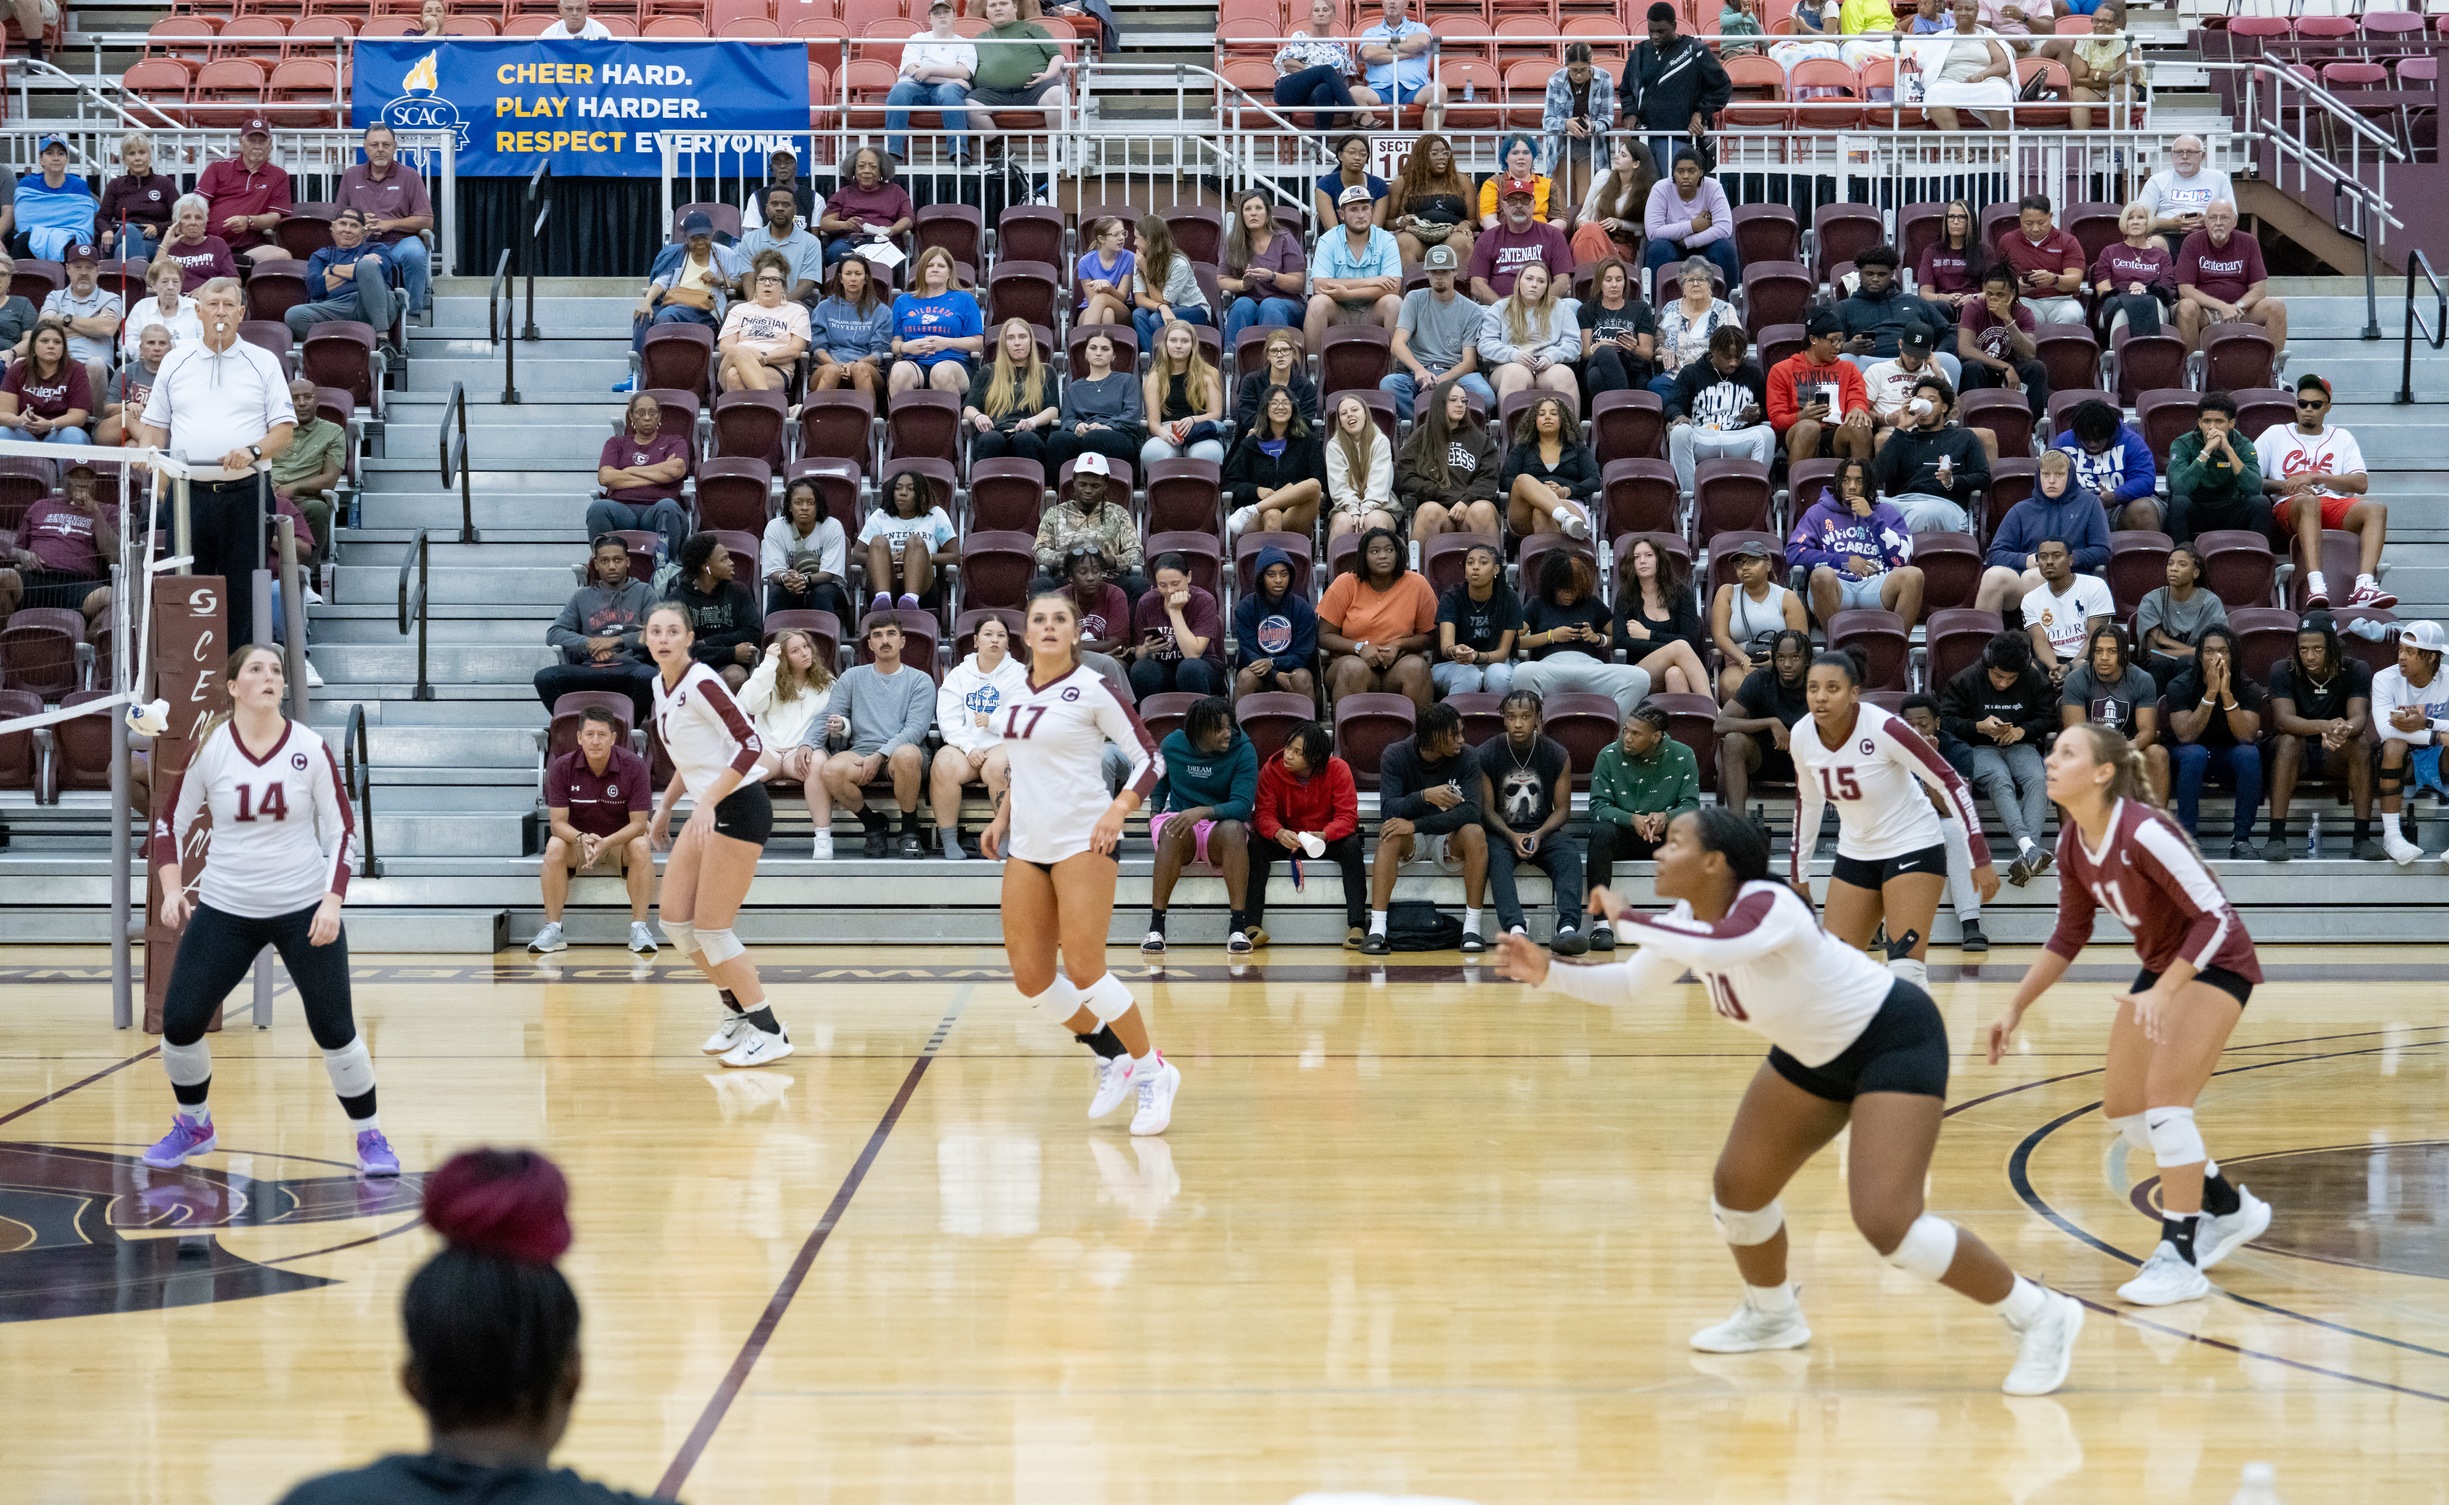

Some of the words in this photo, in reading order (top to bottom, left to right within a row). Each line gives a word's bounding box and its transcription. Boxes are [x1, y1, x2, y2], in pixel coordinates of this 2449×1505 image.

[496, 63, 593, 84] CHEER
[602, 64, 692, 85] HARD.
[393, 107, 447, 126] SCAC
[496, 96, 570, 117] PLAY
[578, 96, 707, 118] HARDER.
[496, 131, 626, 152] RESPECT
[2199, 256, 2243, 273] Centenary
[907, 306, 953, 317] WILDCATS
[741, 317, 787, 331] CHRISTIAN
[1834, 541, 1881, 555] CARES
[1003, 704, 1047, 740] 17
[2093, 716, 2126, 724] CENTENARY
[1187, 765, 1212, 774] DREAM
[1819, 765, 1862, 801] 15
[234, 780, 288, 822] 14
